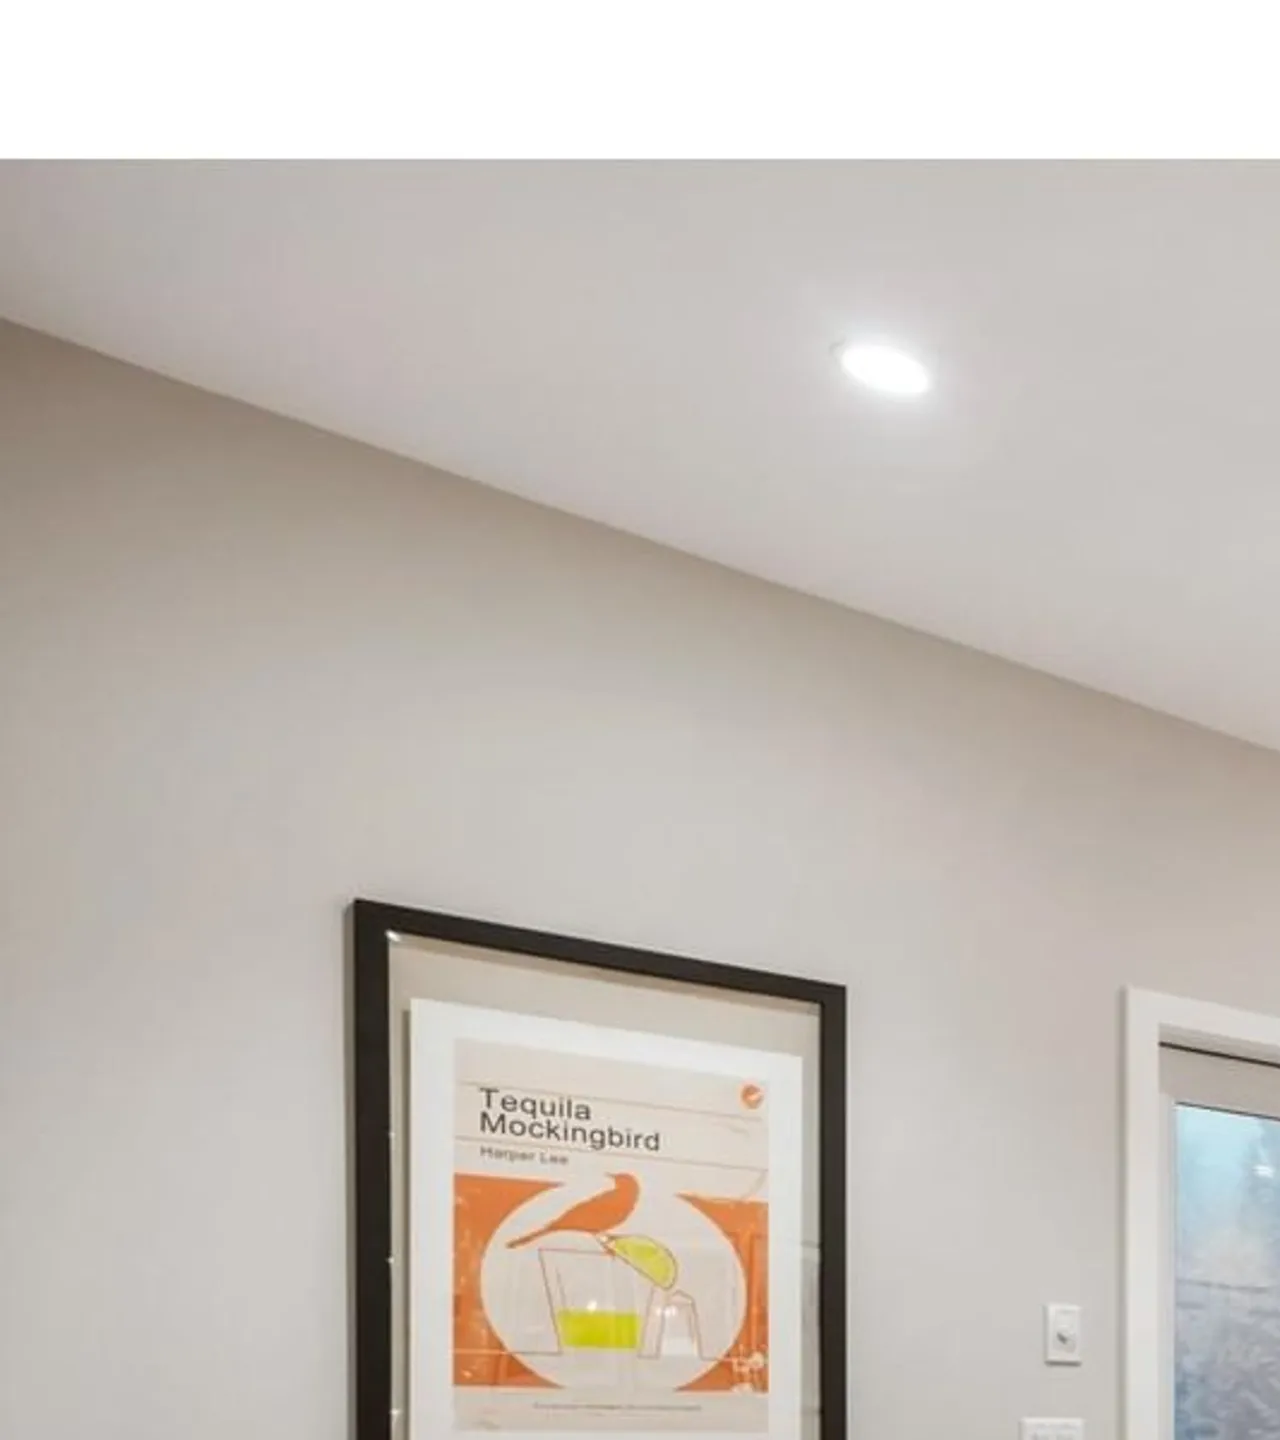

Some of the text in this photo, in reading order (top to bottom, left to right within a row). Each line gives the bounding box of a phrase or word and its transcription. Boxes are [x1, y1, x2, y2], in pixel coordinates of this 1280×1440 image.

[480, 1086, 591, 1120] Tequila
[480, 1111, 660, 1151] Mockingbird
[480, 1146, 569, 1166] Harper Lee
